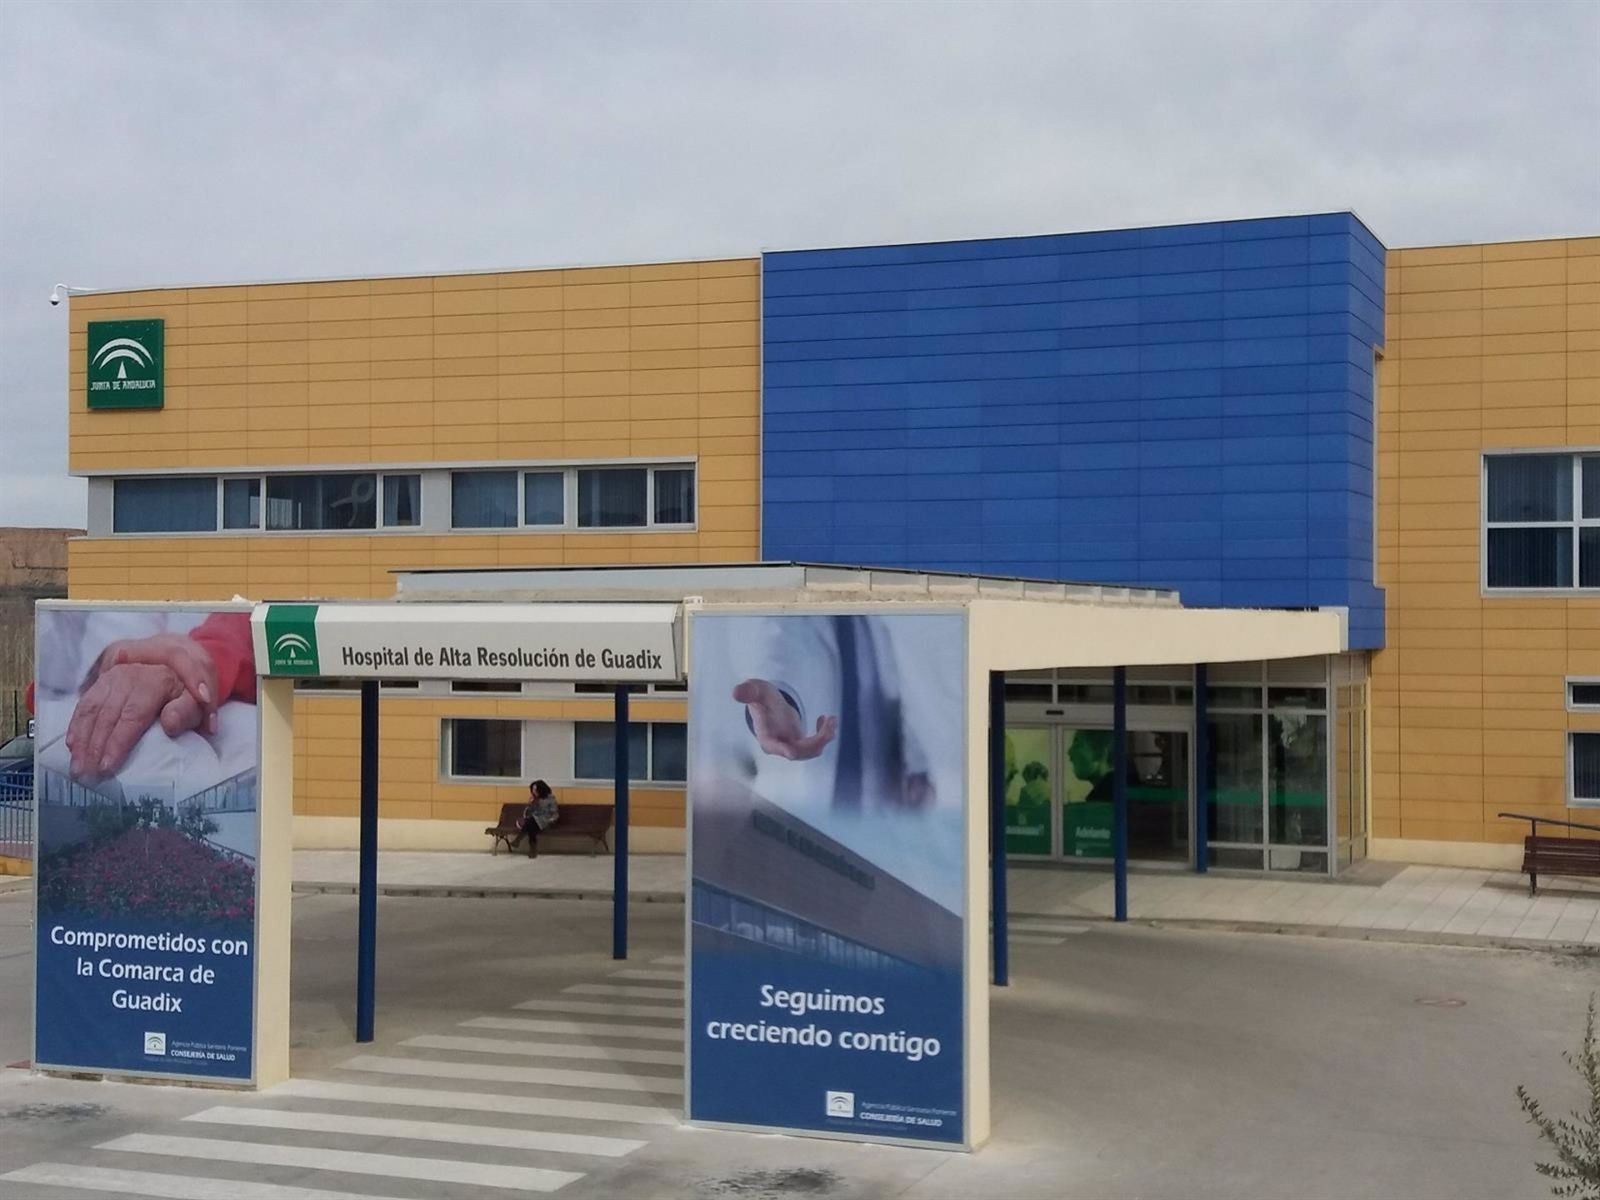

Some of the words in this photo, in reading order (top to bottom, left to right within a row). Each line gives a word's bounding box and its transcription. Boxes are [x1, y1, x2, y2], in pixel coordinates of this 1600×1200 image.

[91, 381, 111, 391] JUNTA
[112, 381, 121, 390] DE
[342, 646, 409, 670] Hospital
[414, 647, 434, 666] de
[439, 647, 472, 666] Alta
[477, 646, 569, 667] Resolución
[575, 649, 596, 668] de
[601, 649, 662, 669] Guadix
[51, 926, 206, 953] Comprometidos
[211, 938, 248, 956] con
[76, 957, 93, 976] la
[98, 958, 184, 983] Comarca
[189, 965, 215, 984] de
[112, 990, 182, 1013] Guadix
[760, 984, 885, 1016] Seguimos
[707, 1020, 832, 1047] creciendo
[839, 1031, 941, 1061] contigo
[206, 1052, 216, 1060] DE
[216, 1053, 236, 1062] SALUD
[905, 1116, 916, 1124] DE
[916, 1117, 943, 1127] SALUD
